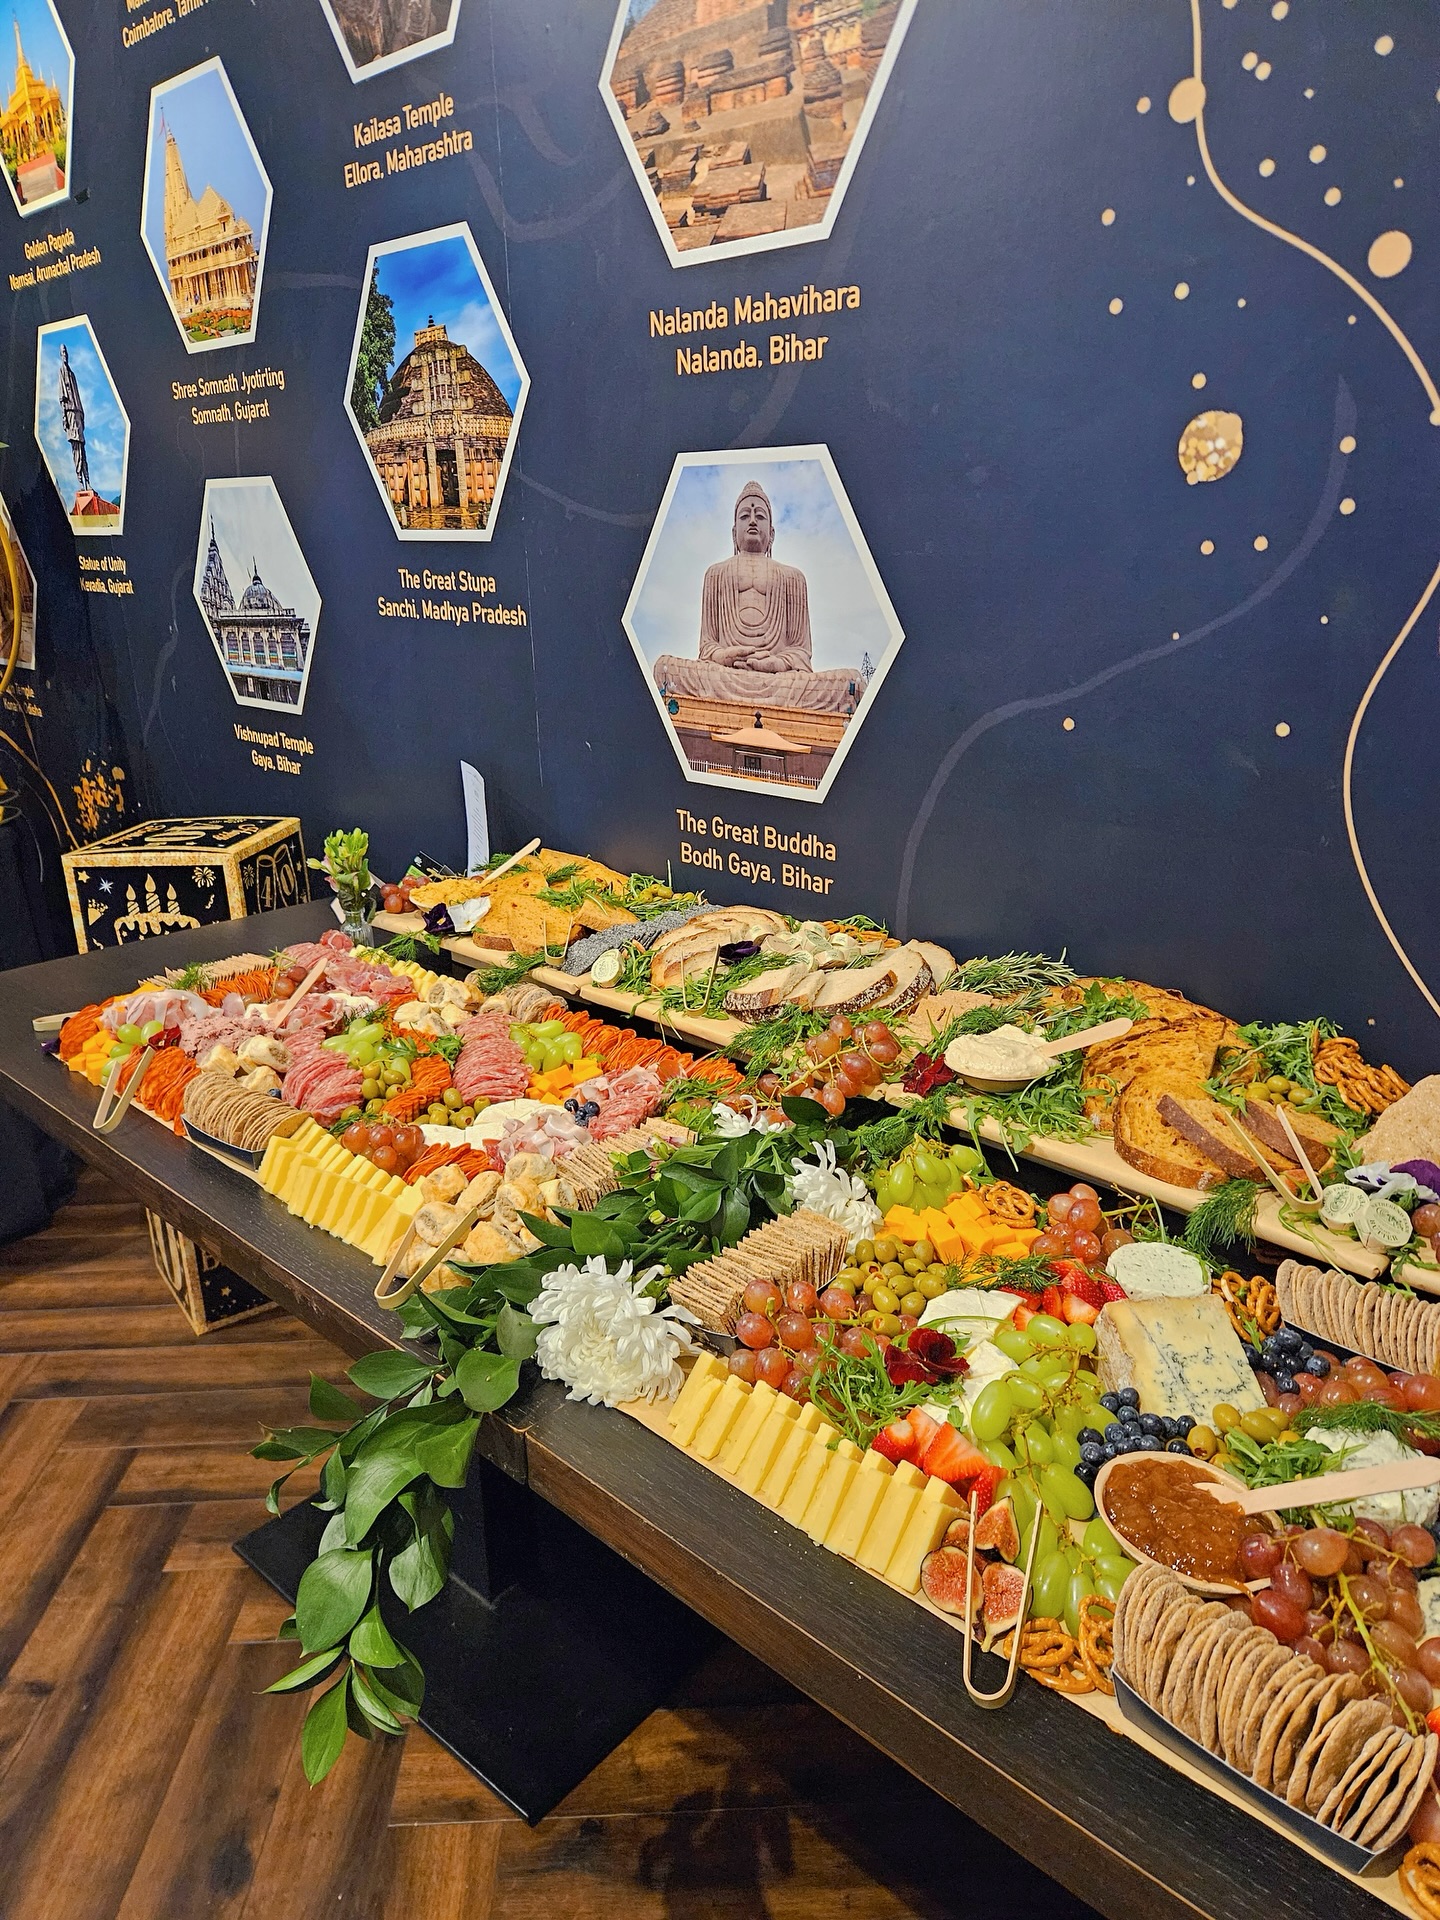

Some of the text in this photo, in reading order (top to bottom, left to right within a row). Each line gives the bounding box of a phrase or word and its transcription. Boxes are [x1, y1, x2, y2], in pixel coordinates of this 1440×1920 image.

[122, 8, 176, 48] Coimbatore,
[353, 92, 454, 149] Kailasa Temple
[344, 130, 473, 189] Ellora, Maharashtra
[24, 227, 75, 261] Golden Pagoda
[36, 255, 71, 282] Arunachal
[70, 245, 101, 272] Pradesh
[649, 284, 861, 338] Nalanda Mahavihara
[676, 333, 829, 376] Nalanda, Bihar
[171, 367, 285, 400] Shree Somnath Jyotirling
[191, 399, 270, 425] Somnath, Gujarat
[78, 555, 126, 575] Statue of Unity
[107, 578, 134, 597] Gujarat
[397, 568, 496, 597] The Great Stupa
[377, 596, 527, 626] Sanchi, Madhya Pradesh
[233, 723, 314, 756] Vishnupad Temple
[276, 754, 301, 775] Bihar
[676, 808, 837, 861] The Great Buddha
[680, 842, 834, 895] Bodh Gaya, Bihar
